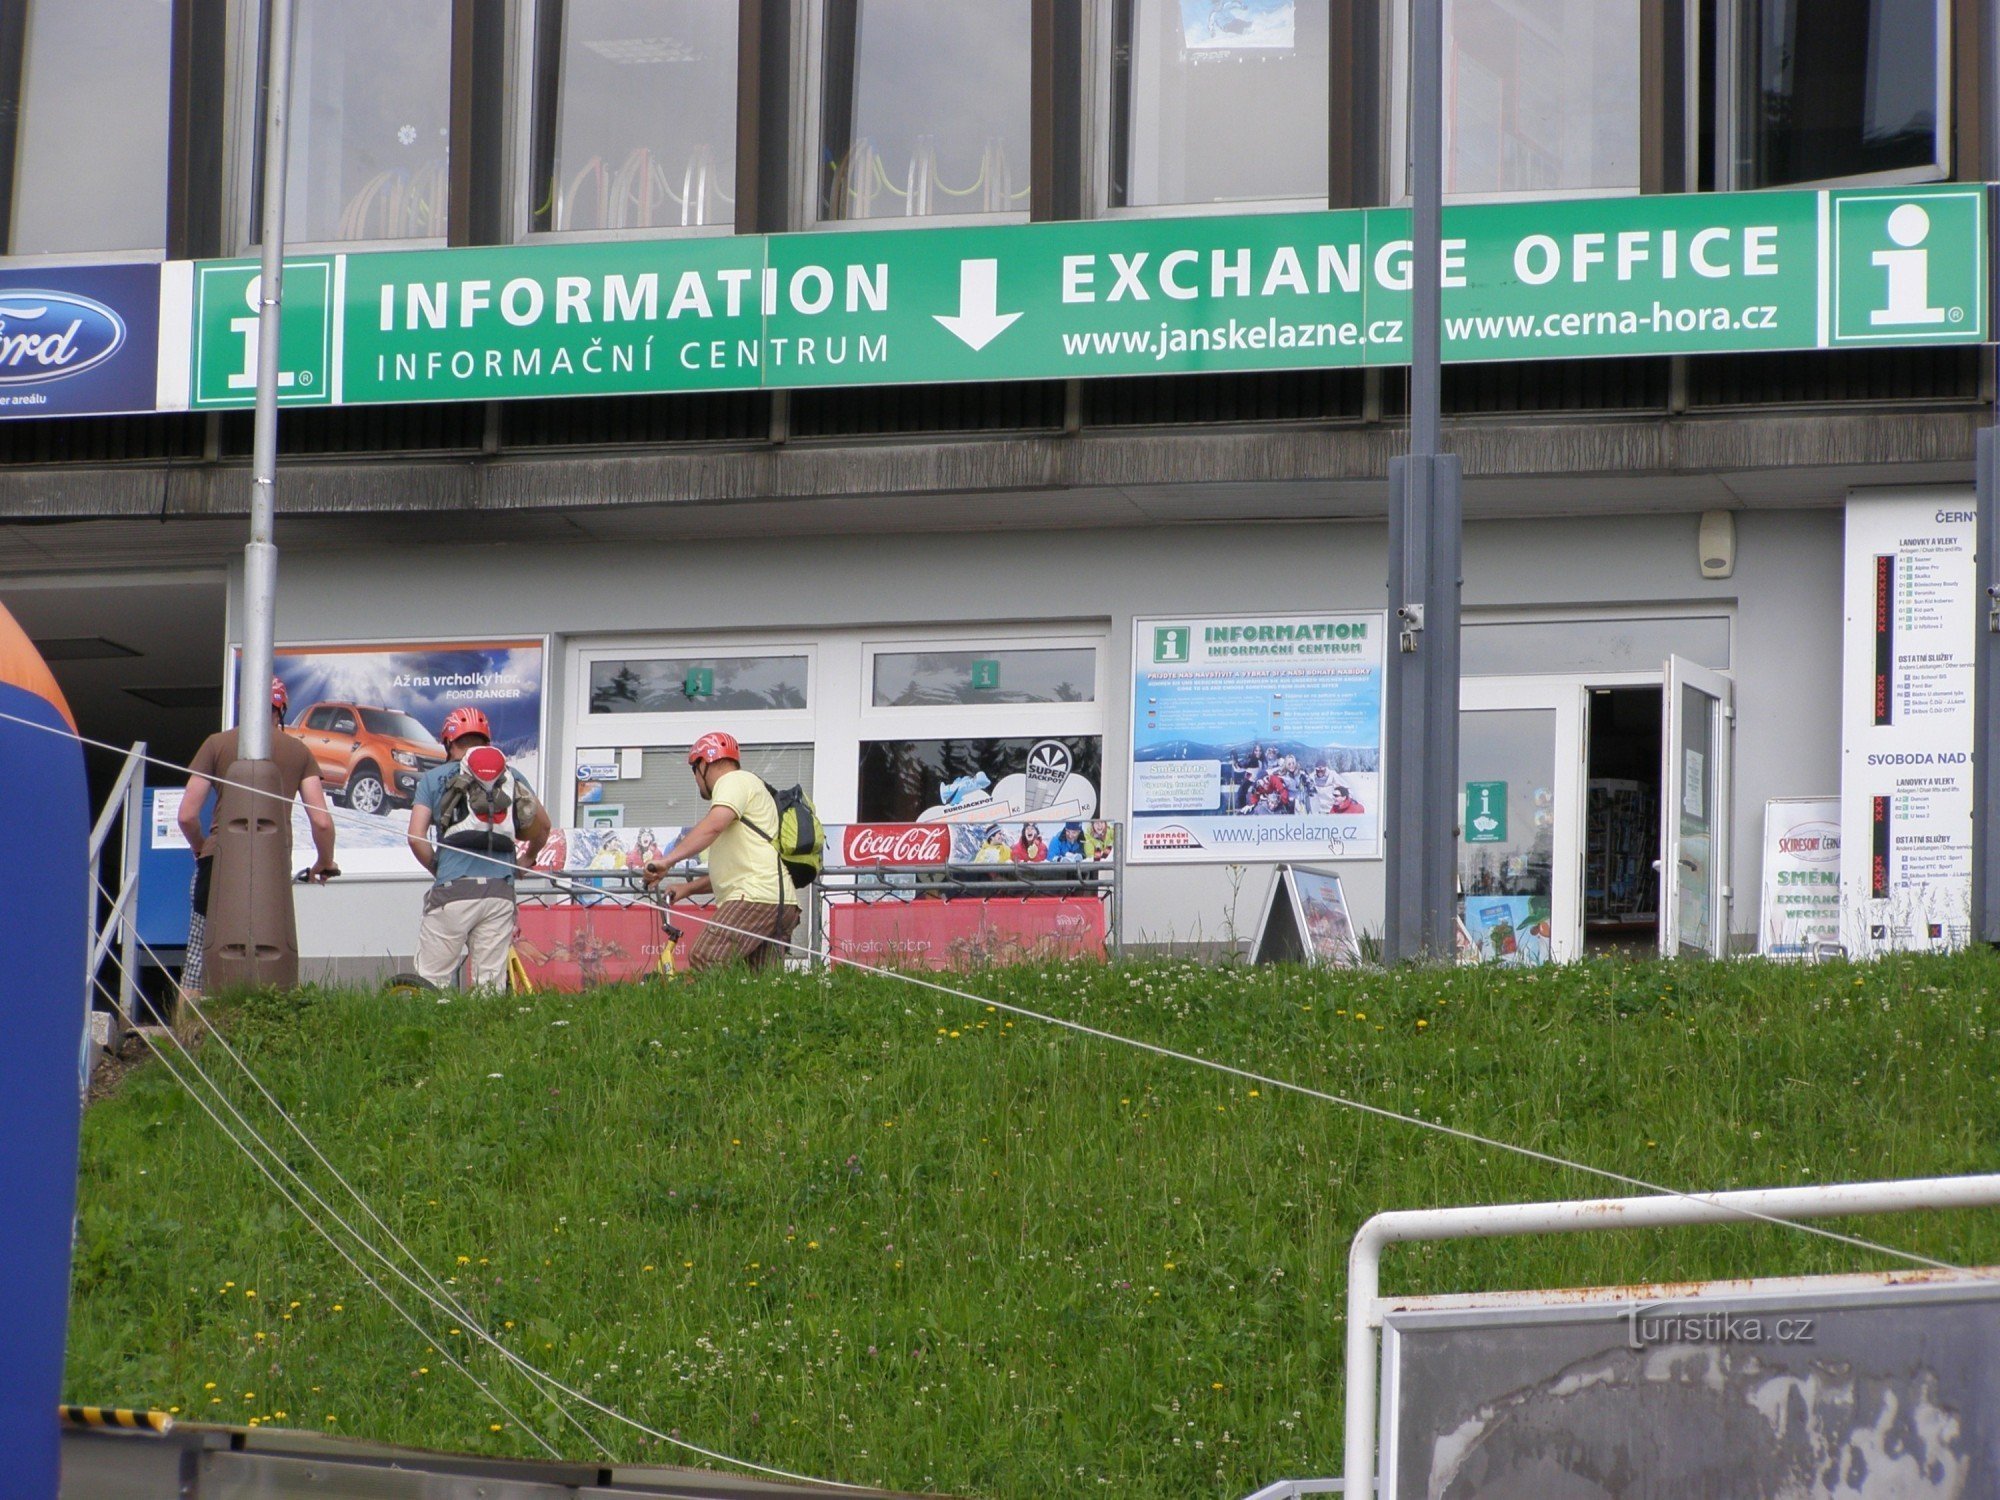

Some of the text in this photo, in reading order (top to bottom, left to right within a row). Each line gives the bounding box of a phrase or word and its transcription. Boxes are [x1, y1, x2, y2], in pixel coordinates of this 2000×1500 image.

[1062, 226, 1779, 302] EXCHANGE OFFICE
[380, 263, 888, 331] INFORMATION
[1446, 301, 1777, 340] www.cerna-hora.cz
[1063, 316, 1403, 360] www.janskelazne.cz
[378, 334, 887, 382] INFORMAČNÍ CENTRUM
[12, 393, 47, 405] areálu
[1899, 538, 1930, 546] LANOVKY
[1937, 537, 1958, 545] VLEKY
[1204, 622, 1368, 643] INFORMATION
[1208, 642, 1362, 657] INFORMAČNÍ CENTRUM
[1898, 652, 1953, 663] OSTATNÍ SLUŽBY
[393, 672, 521, 687] Až na vrcholky hor.
[446, 689, 520, 700] FORD RANGER
[1867, 752, 1967, 765] SVOBODA NAD
[1028, 764, 1066, 779] SUPER
[1028, 774, 1063, 784] JACKPOT
[1896, 778, 1927, 786] LANOVKY
[1934, 777, 1955, 785] VLEKY
[944, 797, 994, 814] EUROJACKPOT
[1213, 823, 1358, 846] www.janskelazne.cz
[1895, 834, 1951, 844] OSTATNÍ SLUŽBY
[1779, 837, 1820, 853] SKIRESORT
[641, 943, 686, 956] radst
